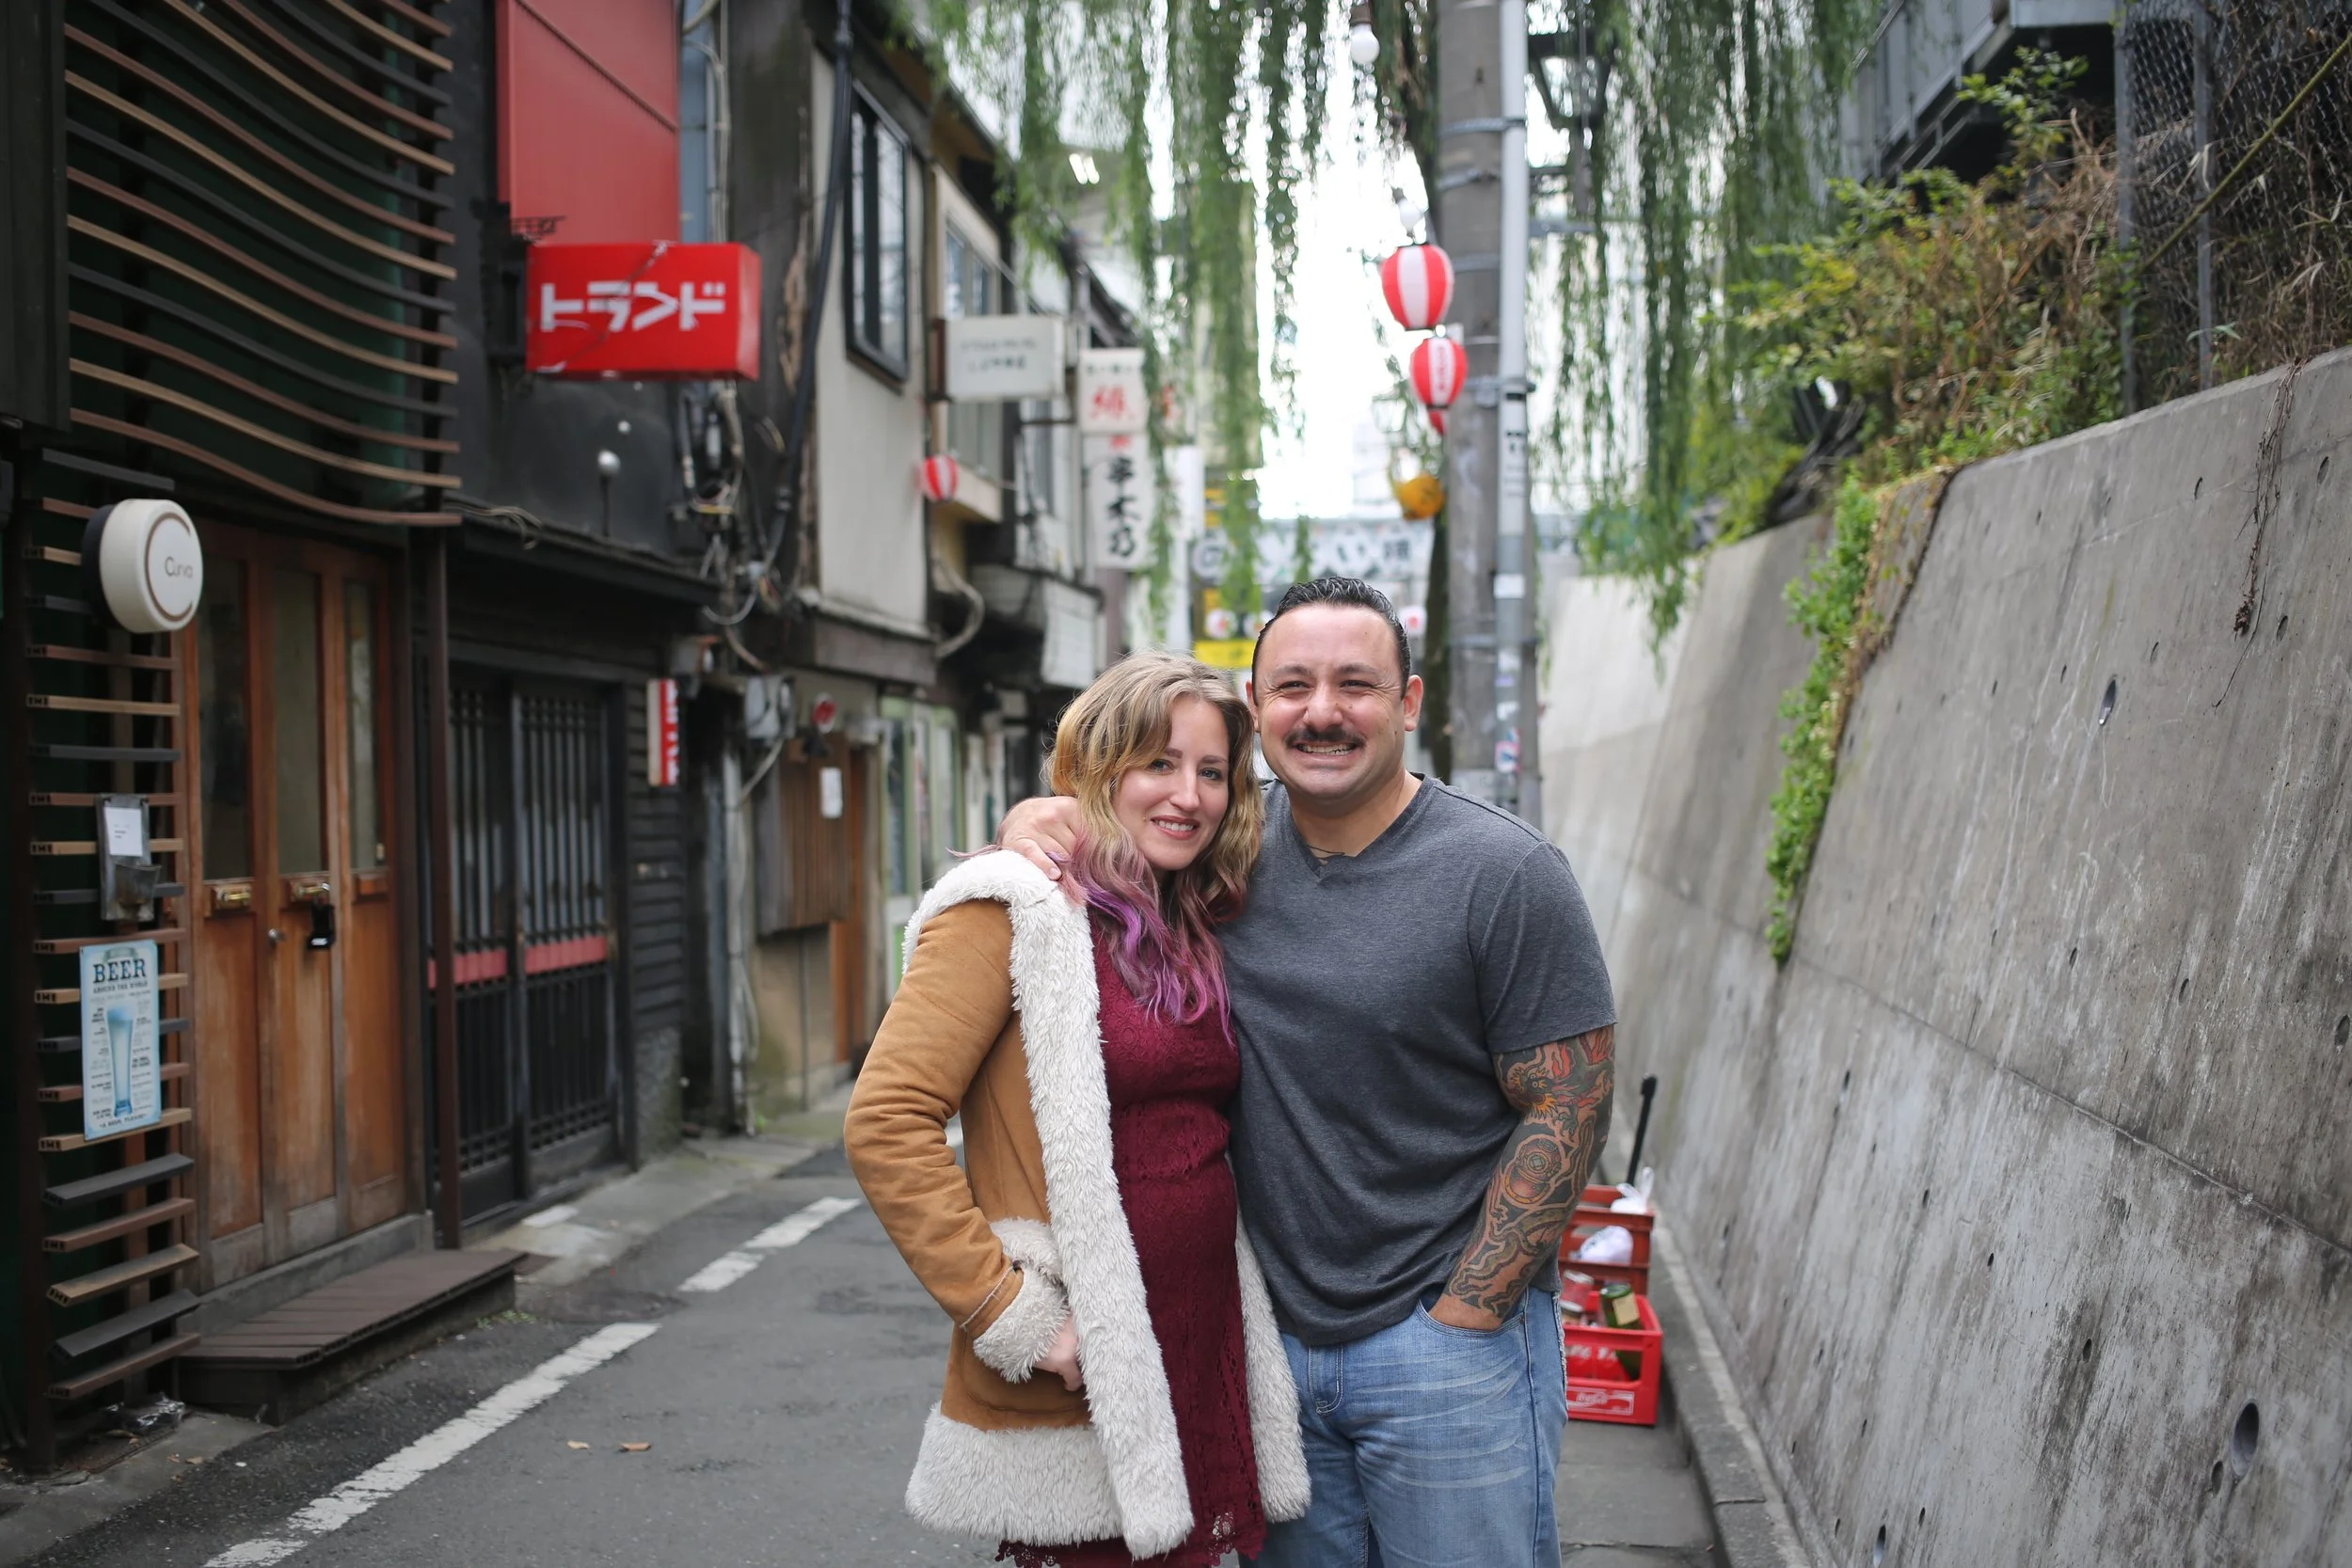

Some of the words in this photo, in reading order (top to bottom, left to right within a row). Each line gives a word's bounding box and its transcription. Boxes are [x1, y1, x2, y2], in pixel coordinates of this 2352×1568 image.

[541, 281, 726, 332] トランド
[93, 958, 146, 983] BEER
